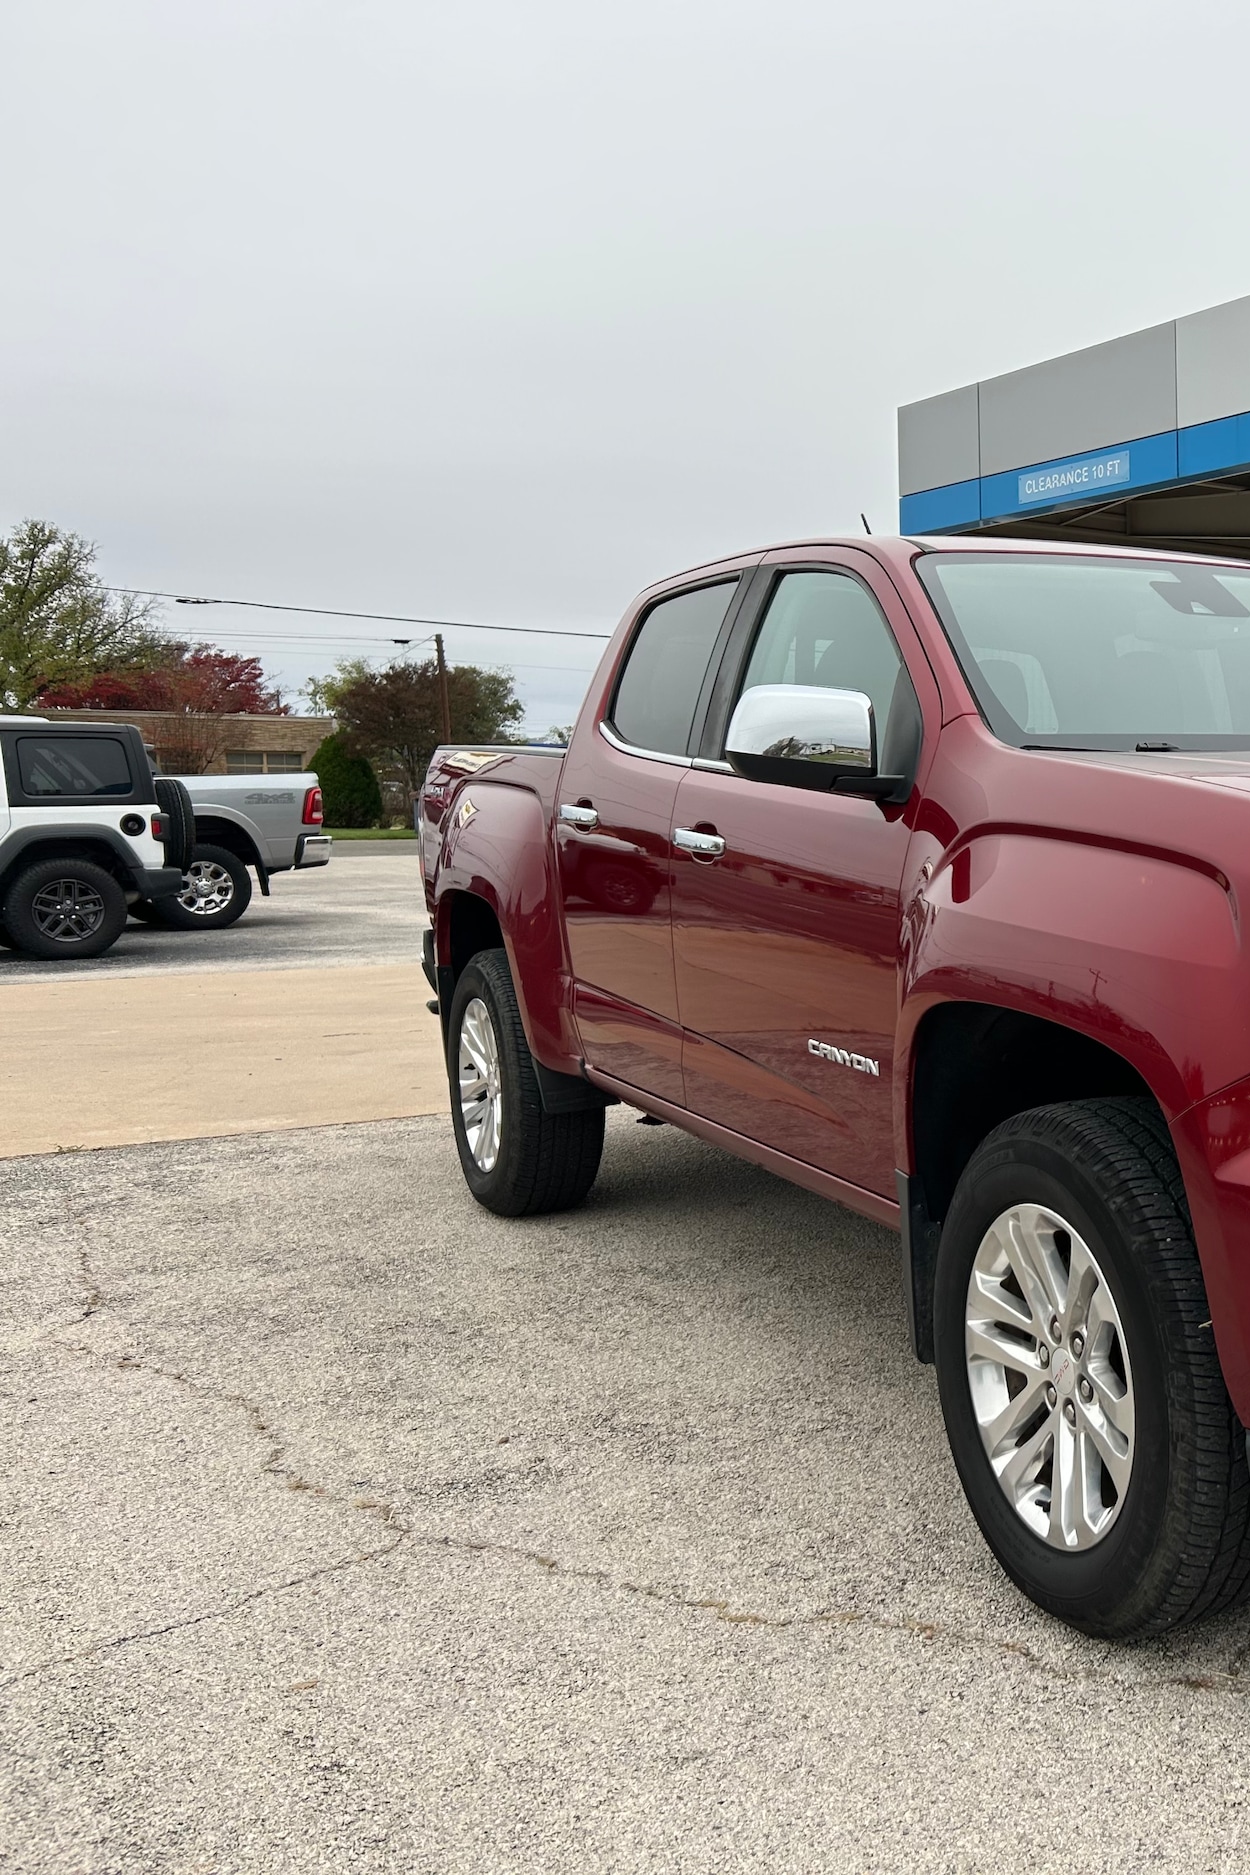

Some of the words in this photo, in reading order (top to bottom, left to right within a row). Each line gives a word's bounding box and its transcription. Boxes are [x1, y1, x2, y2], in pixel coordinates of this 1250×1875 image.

[1025, 466, 1089, 494] CLEARANCE
[1092, 465, 1104, 479] 10
[1107, 460, 1120, 476] FT
[807, 1038, 879, 1077] CANYON
